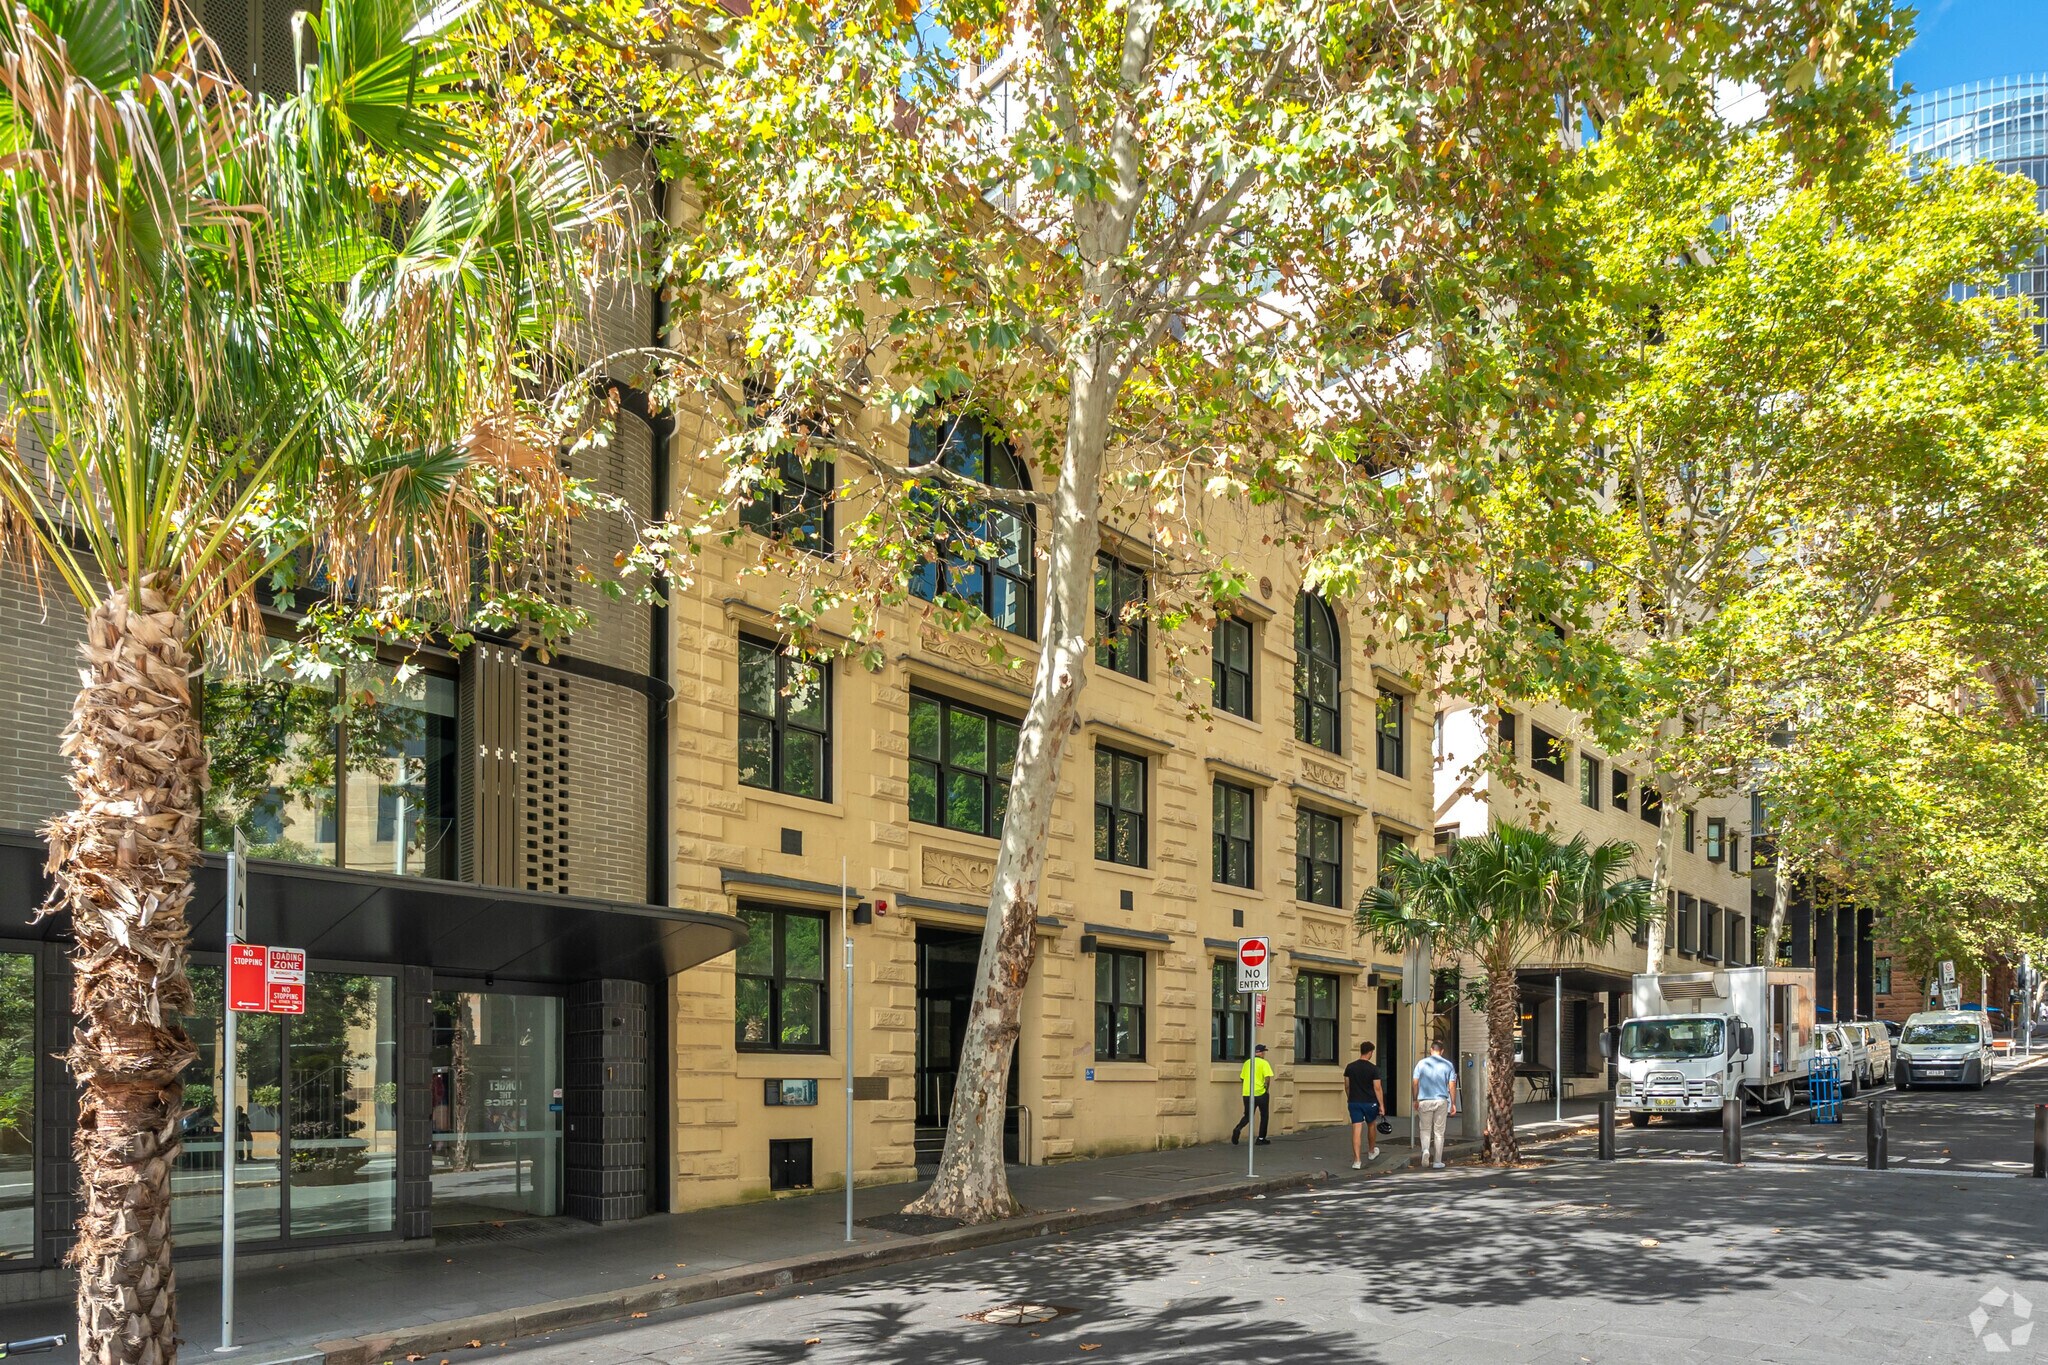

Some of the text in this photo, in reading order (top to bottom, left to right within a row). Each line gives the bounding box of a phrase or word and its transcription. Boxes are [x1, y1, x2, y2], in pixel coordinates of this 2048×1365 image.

[243, 949, 254, 957] NO
[271, 952, 302, 962] LOADING
[233, 957, 263, 966] STOPPING
[273, 961, 300, 970] ZONE
[1245, 969, 1260, 979] NO
[1239, 980, 1266, 989] ENTRY
[273, 992, 299, 1000] STOPPING
